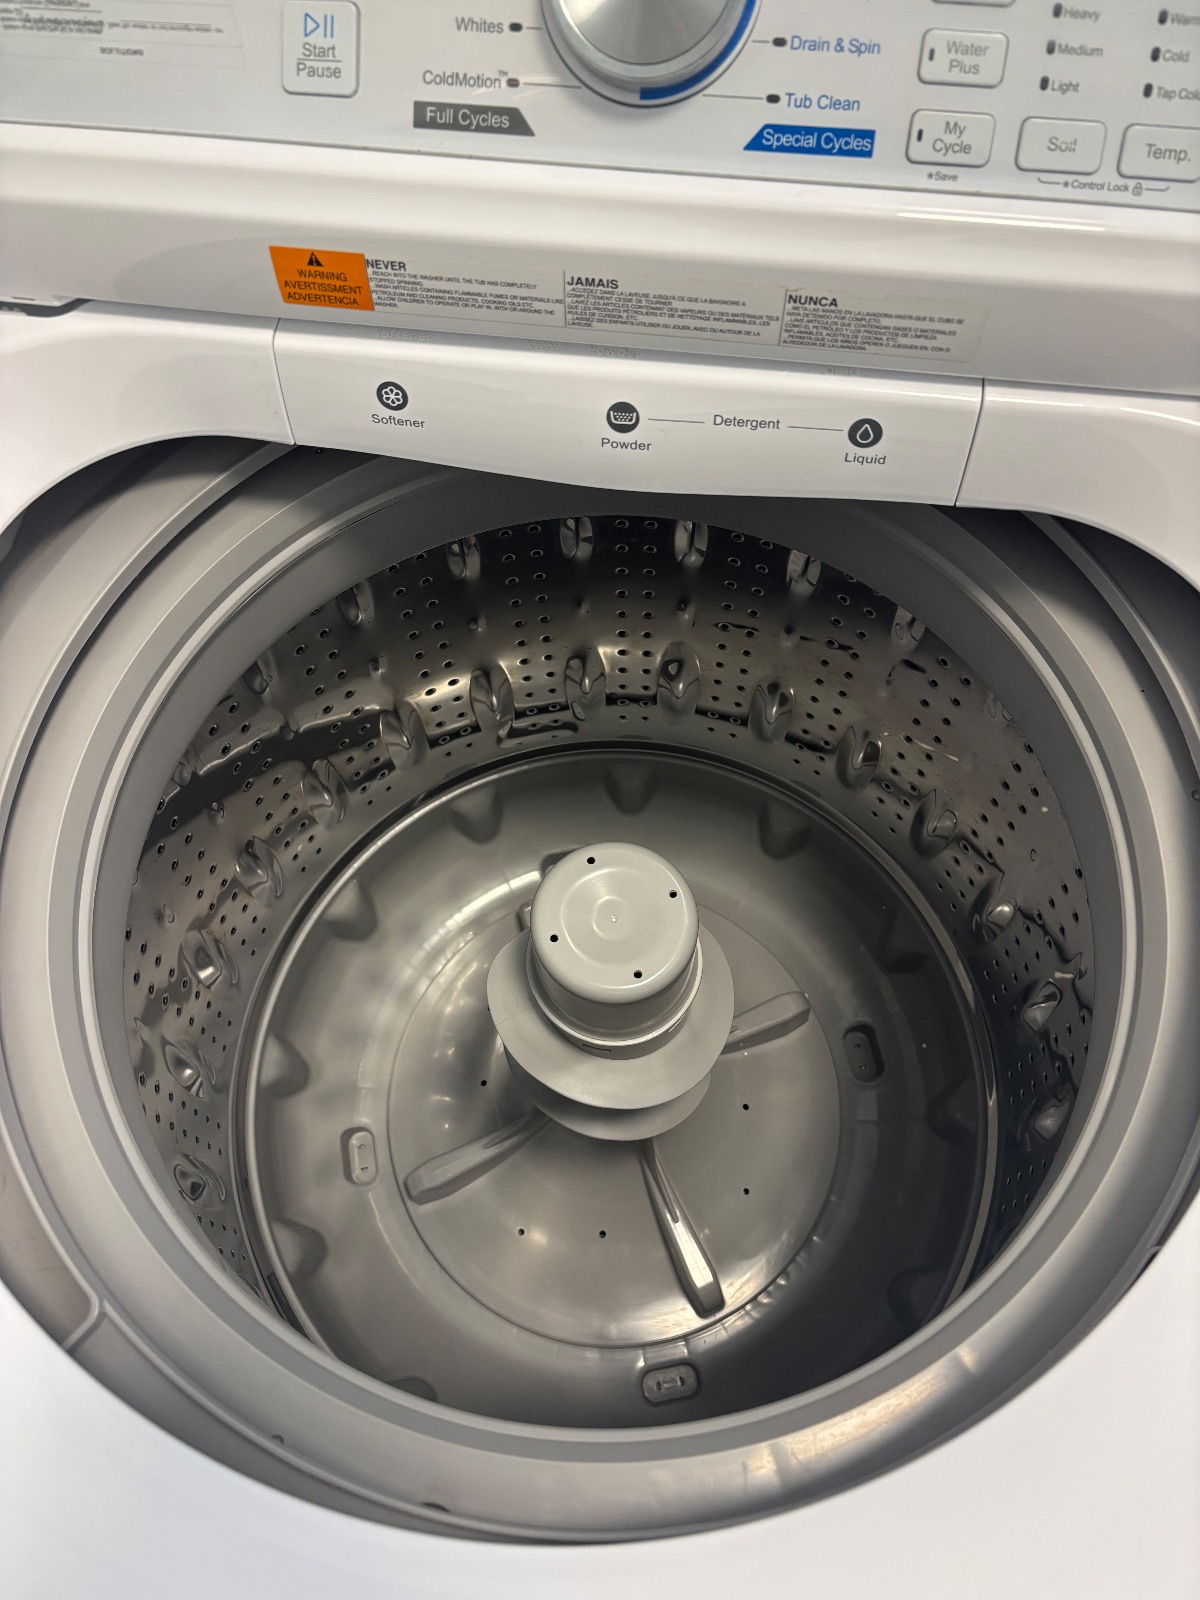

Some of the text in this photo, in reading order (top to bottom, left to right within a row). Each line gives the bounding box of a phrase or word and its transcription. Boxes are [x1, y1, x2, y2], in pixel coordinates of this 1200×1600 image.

[1063, 8, 1101, 22] Heavy
[455, 16, 504, 34] Whites
[302, 42, 336, 58] Start
[790, 34, 880, 57] Drain & Spin
[946, 40, 990, 57] Water
[1057, 43, 1103, 57] Medium
[1162, 48, 1190, 62] Cold
[296, 62, 342, 78] Pause
[948, 59, 980, 75] Plus
[1051, 80, 1080, 94] Light
[1157, 86, 1200, 101] Tap Col
[785, 92, 860, 111] Tub Clean
[426, 106, 510, 130] Full Cycles
[944, 121, 966, 138] My
[762, 128, 872, 153] Special Cycles
[932, 138, 972, 156] Cycle
[1047, 136, 1078, 153] Soil
[1145, 143, 1192, 164] Temp.
[1071, 180, 1129, 193] Control Lock
[366, 259, 406, 272] NEVER
[297, 268, 348, 282] WARNING
[370, 277, 395, 285] STOPPED
[284, 280, 362, 295] AVERTISSMENT
[500, 282, 537, 290] COMPLETELY
[567, 276, 619, 290] JAMAIS
[288, 292, 360, 306] ADVERTENCIA
[397, 297, 425, 305] CHILDREN
[420, 287, 453, 295] CONTAINING
[455, 290, 488, 298] FLAMMABLE
[519, 296, 551, 304] MATERIALS
[709, 299, 740, 307] BAIGNOIRE
[787, 294, 838, 308] NUNCA
[592, 306, 621, 314] PRODUITS
[677, 314, 711, 322] NETTOYAGE
[630, 304, 665, 312] CONTENANT
[679, 308, 707, 316] VAPEURS
[371, 412, 425, 429] Softener
[713, 414, 780, 432] Detergent
[601, 438, 652, 452] Powder
[844, 453, 886, 467] Liquid
